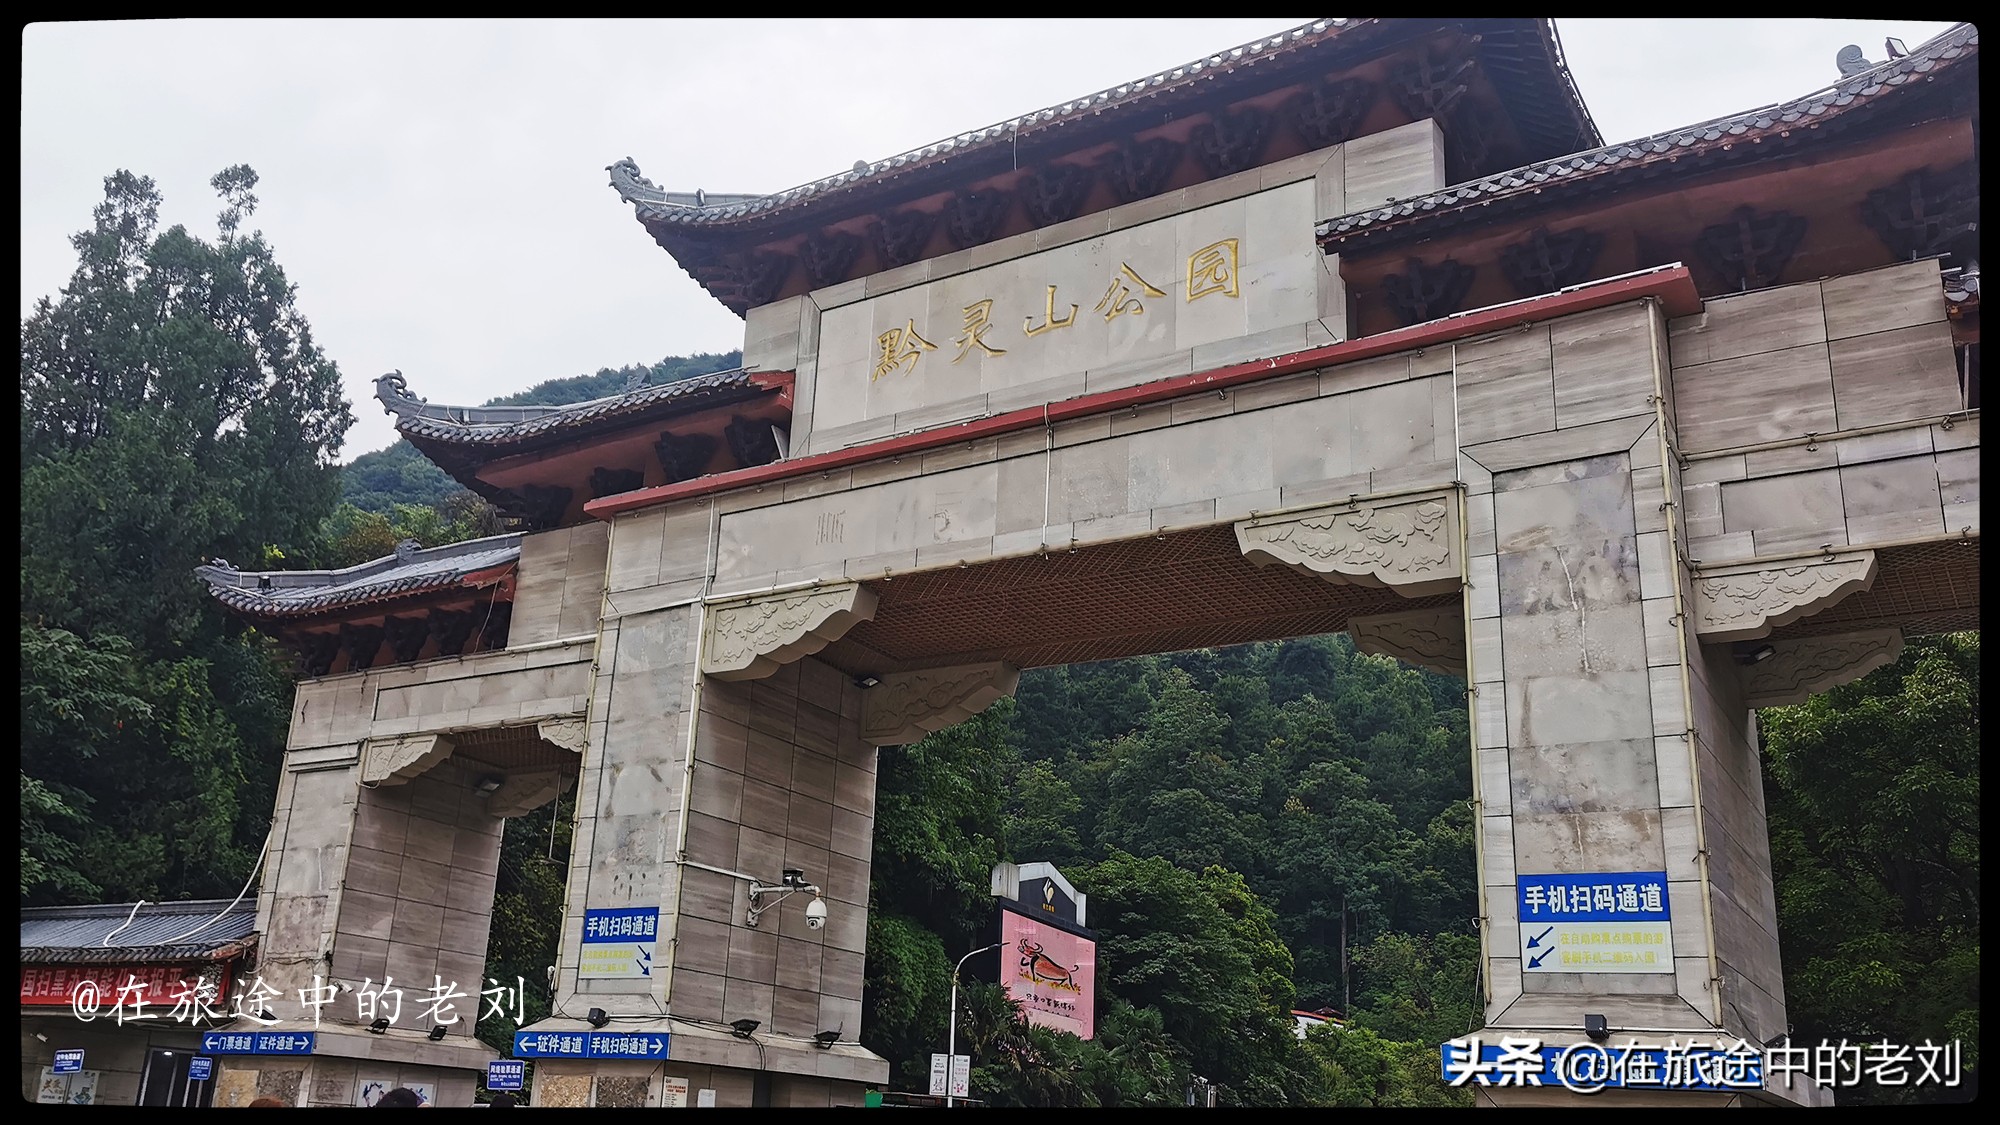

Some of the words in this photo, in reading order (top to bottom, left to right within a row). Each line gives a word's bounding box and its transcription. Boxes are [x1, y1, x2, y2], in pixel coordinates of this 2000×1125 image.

[872, 238, 1240, 382] 黔灵山公园
[1524, 883, 1664, 914] 手机扫码通道
[586, 915, 656, 938] 手机扫码通道
[217, 1036, 252, 1050] 门票通道
[259, 1036, 295, 1050] 证件通道
[537, 1034, 583, 1053] 证件通道
[591, 1037, 649, 1055] 手机扫码通道
